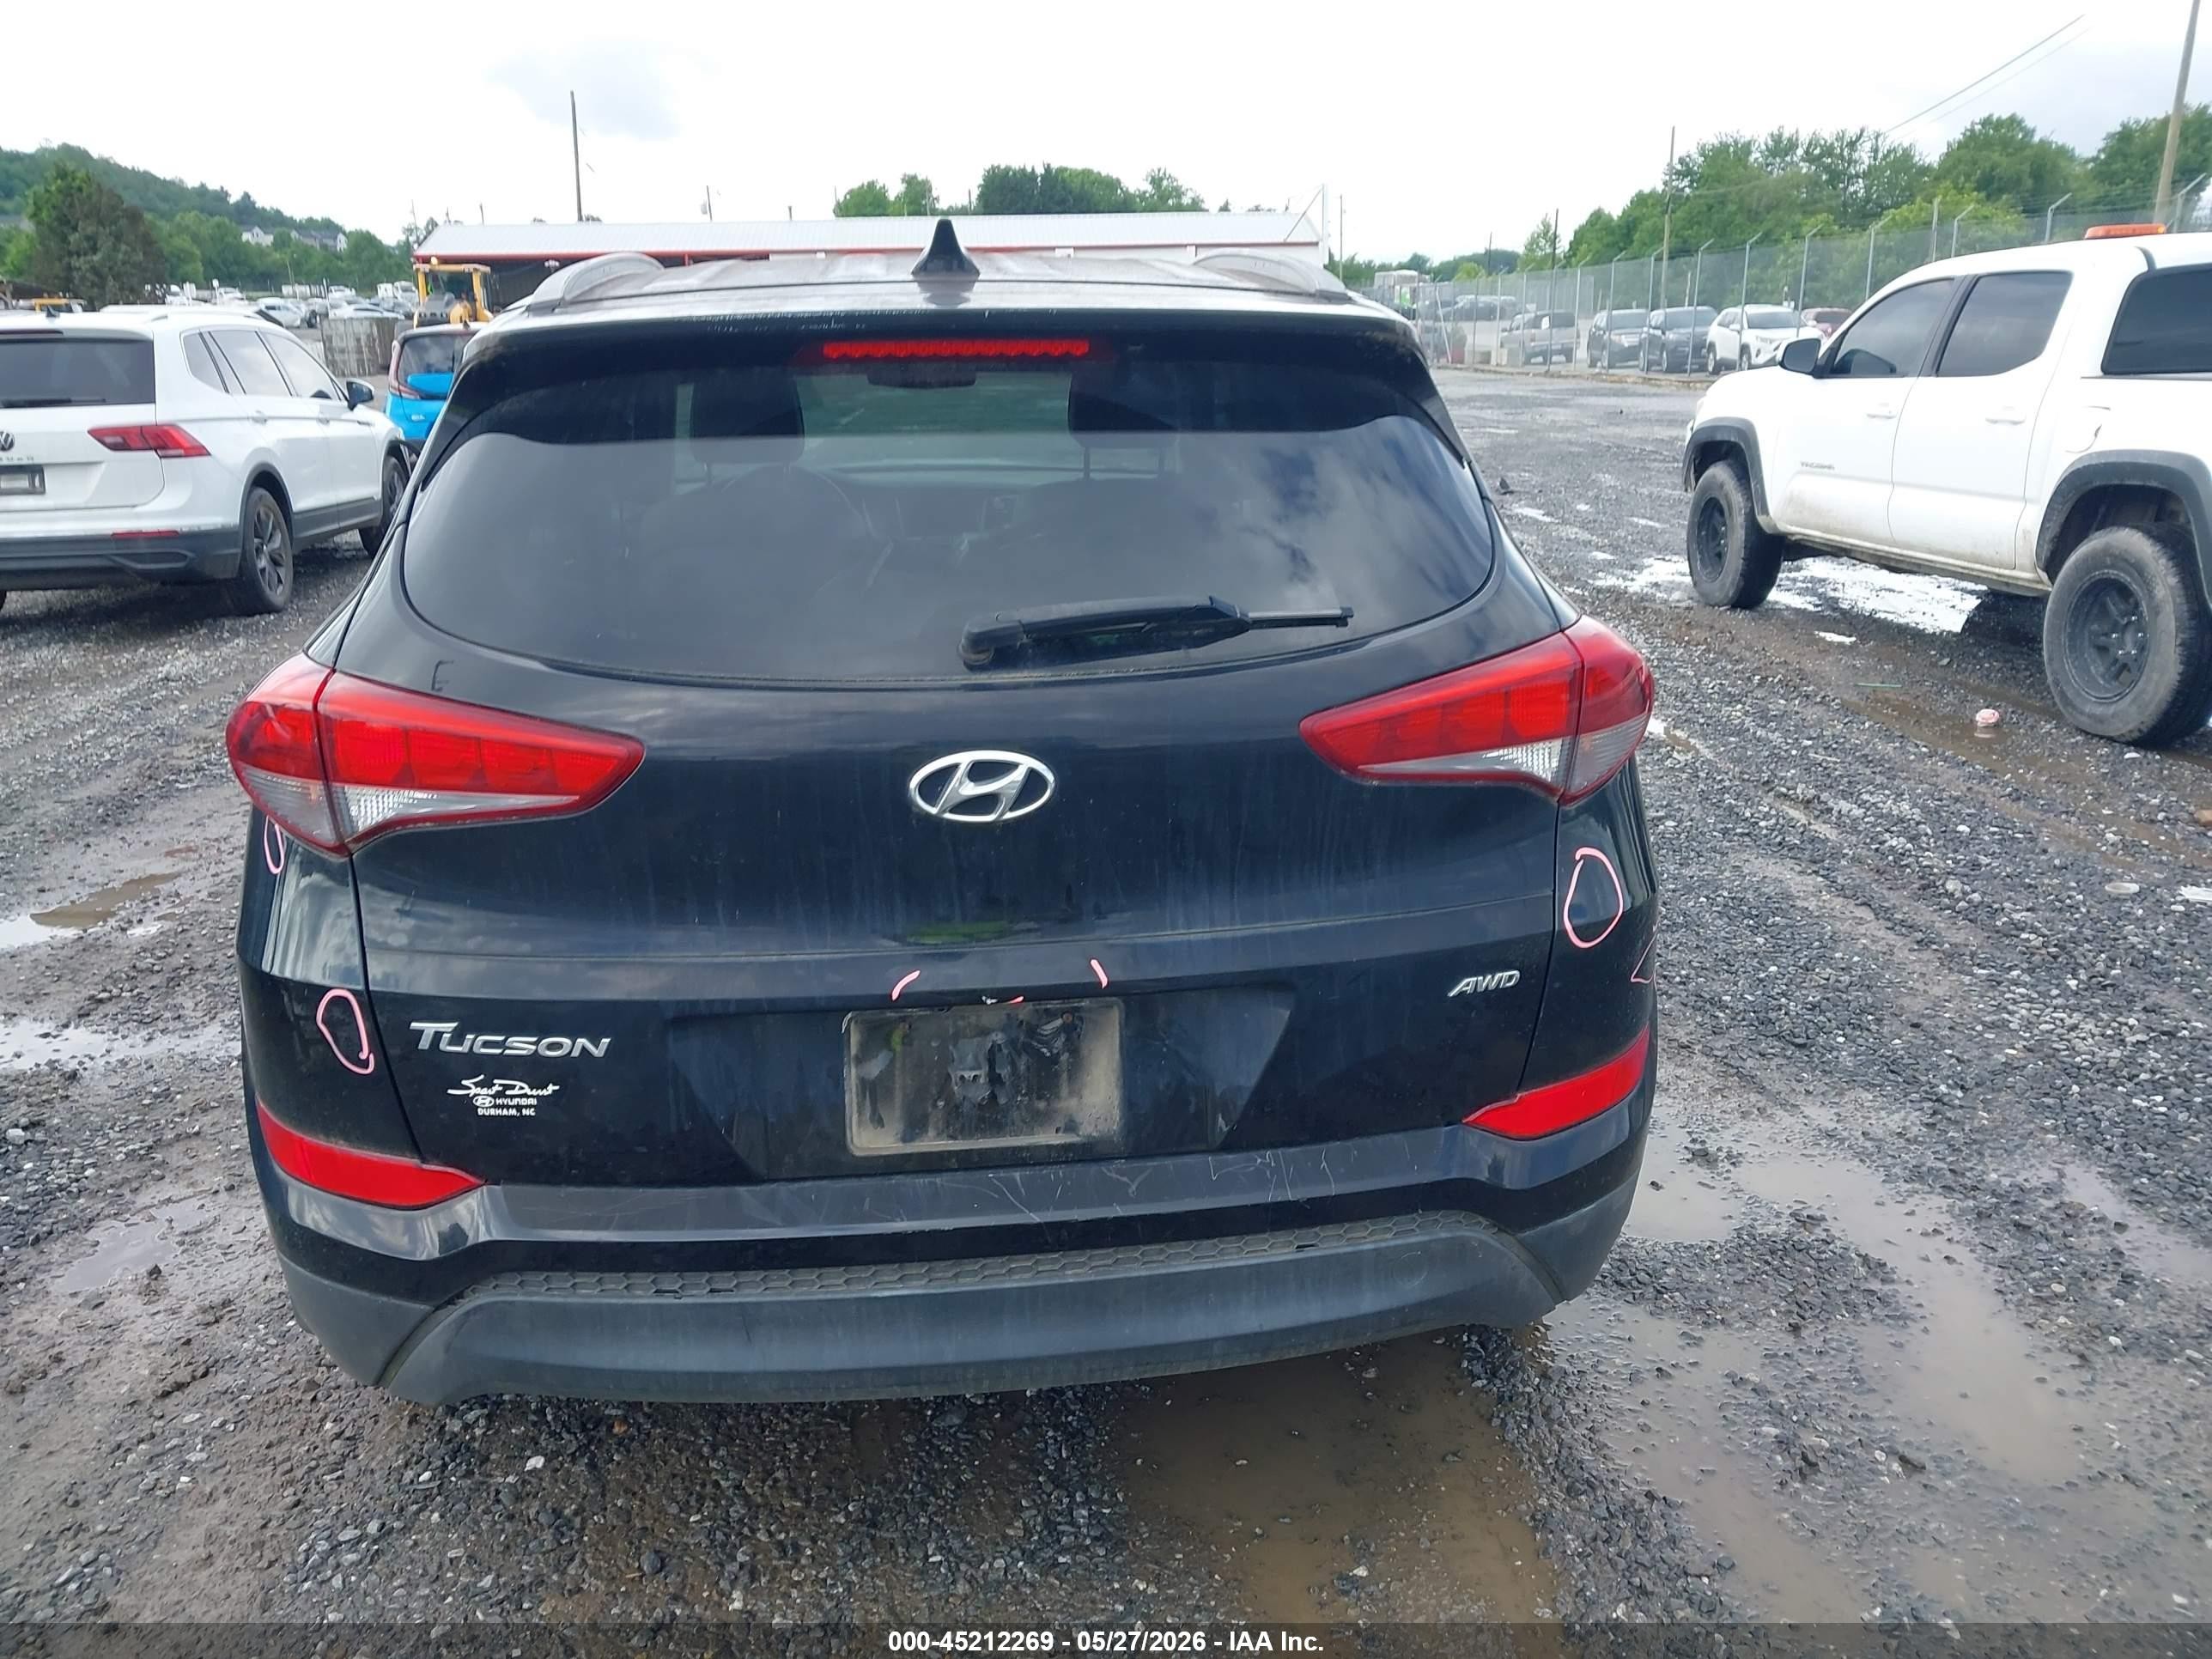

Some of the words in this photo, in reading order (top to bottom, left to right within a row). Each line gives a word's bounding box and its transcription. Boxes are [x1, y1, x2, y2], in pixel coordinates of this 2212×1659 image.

[1447, 969, 1521, 997] AWD
[495, 1097, 538, 1106] HYUNDAI
[477, 1108, 520, 1116] DURHAM,
